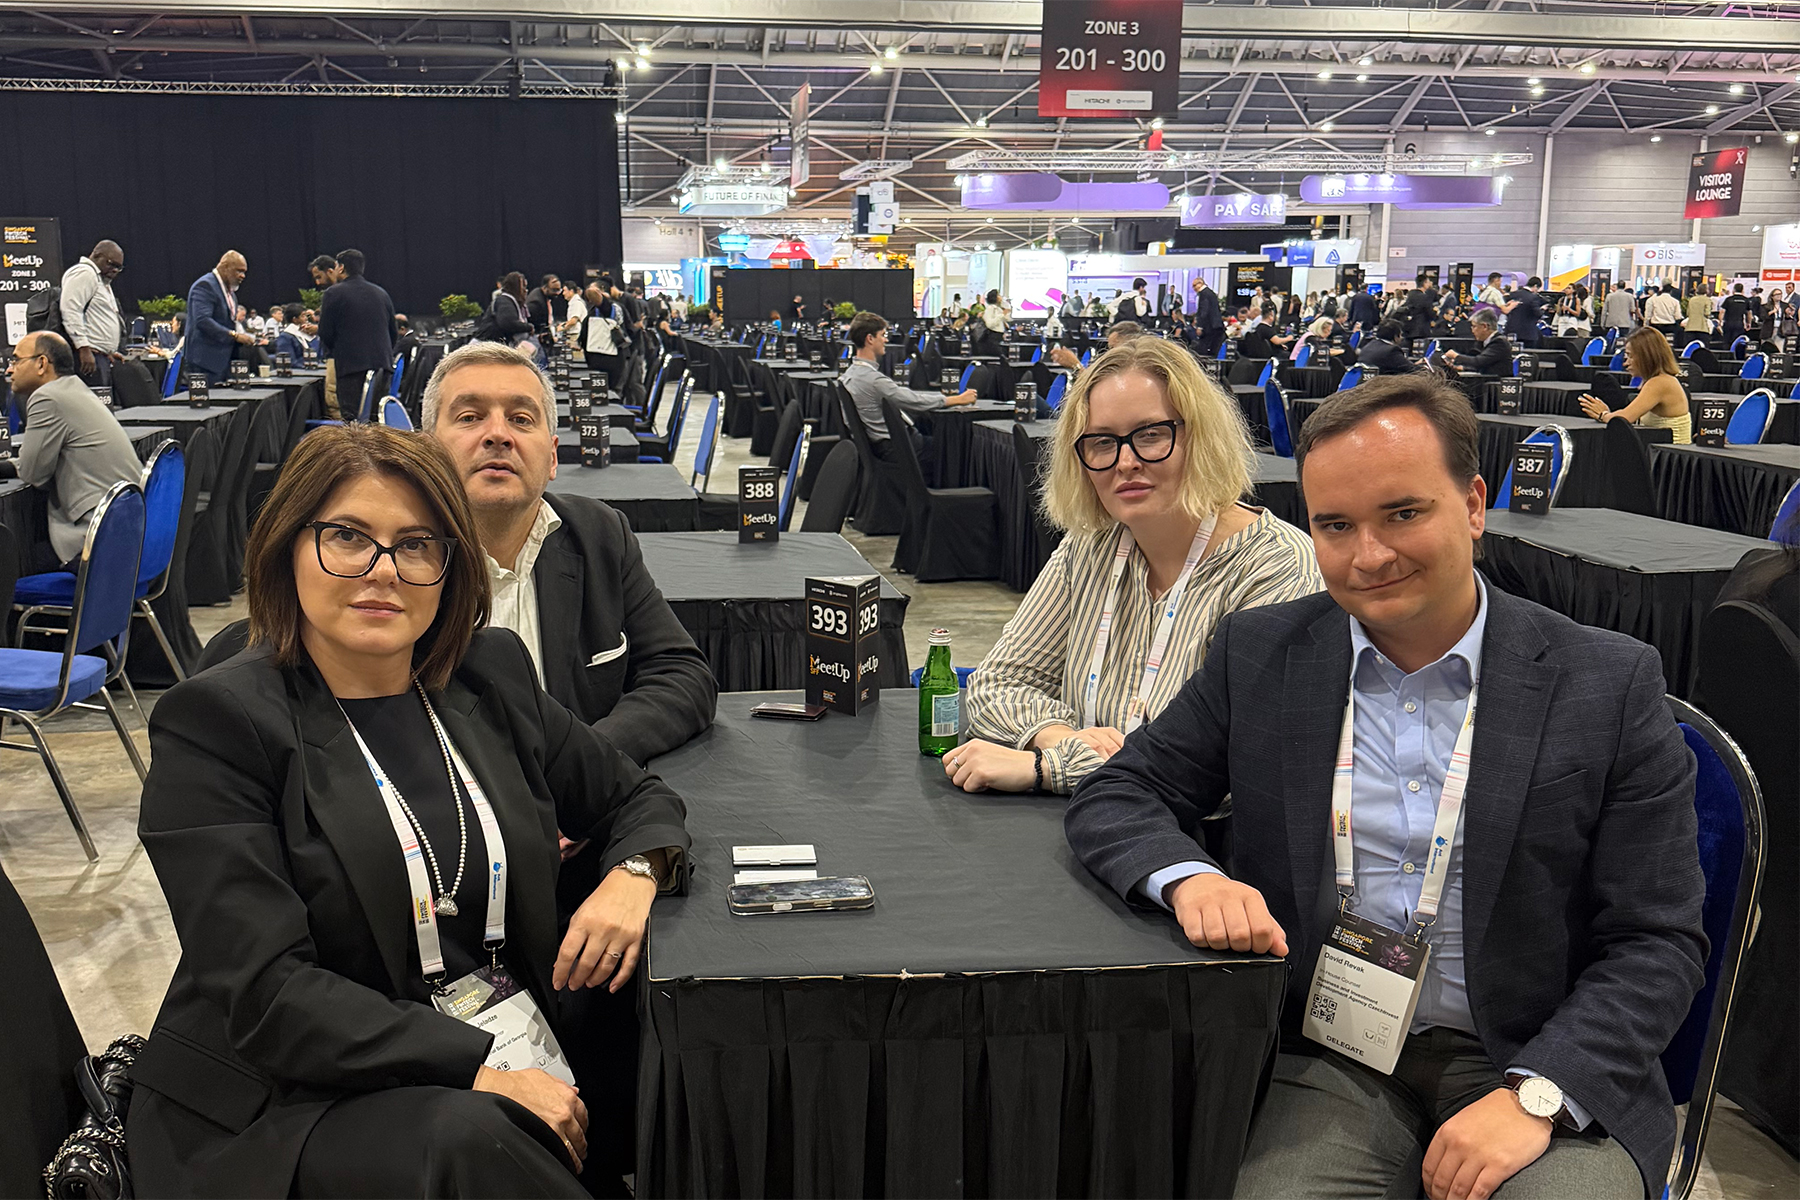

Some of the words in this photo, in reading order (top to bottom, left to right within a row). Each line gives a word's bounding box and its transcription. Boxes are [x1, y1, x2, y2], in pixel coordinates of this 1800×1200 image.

[1085, 20, 1127, 35] ZONE
[1129, 21, 1140, 35] 3
[1055, 47, 1097, 71] 201
[1121, 49, 1166, 72] 300
[1699, 172, 1732, 187] VISITOR
[704, 191, 738, 201] FUTURE
[741, 191, 753, 201] OF
[1695, 186, 1732, 202] LOUNGE
[1214, 203, 1244, 216] PAY
[1250, 202, 1284, 216] SAFE
[659, 227, 677, 236] Hall
[678, 228, 684, 236] 4
[3, 254, 44, 268] MeetUp
[1657, 249, 1675, 260] BIS
[0, 280, 20, 291] 201
[29, 280, 51, 291] 300
[1520, 360, 1532, 368] 345
[1771, 357, 1783, 365] 344
[191, 380, 207, 389] 352
[591, 379, 606, 387] 353
[1501, 385, 1517, 394] 366
[1016, 391, 1028, 400] 367
[575, 398, 590, 408] 368
[1703, 408, 1725, 419] 375
[581, 425, 598, 437] 373
[1516, 457, 1545, 473] 387
[744, 482, 775, 499] 388
[743, 513, 777, 526] MeetUp
[811, 604, 848, 635] 393
[859, 603, 878, 635] 393
[809, 653, 851, 683] MeetUp
[1340, 932, 1363, 944] FINTECH
[1342, 928, 1374, 944] SINGAPORE
[1324, 951, 1344, 965] David
[1344, 960, 1365, 974] Revak
[1315, 981, 1348, 998] Development
[1348, 995, 1368, 1007] Agency
[1317, 975, 1340, 989] Business
[1340, 985, 1350, 993] and
[1350, 990, 1379, 1006] Investment
[495, 1042, 507, 1052] Bank
[511, 1031, 528, 1043] Georgia
[1326, 1035, 1365, 1057] DELEGATE
